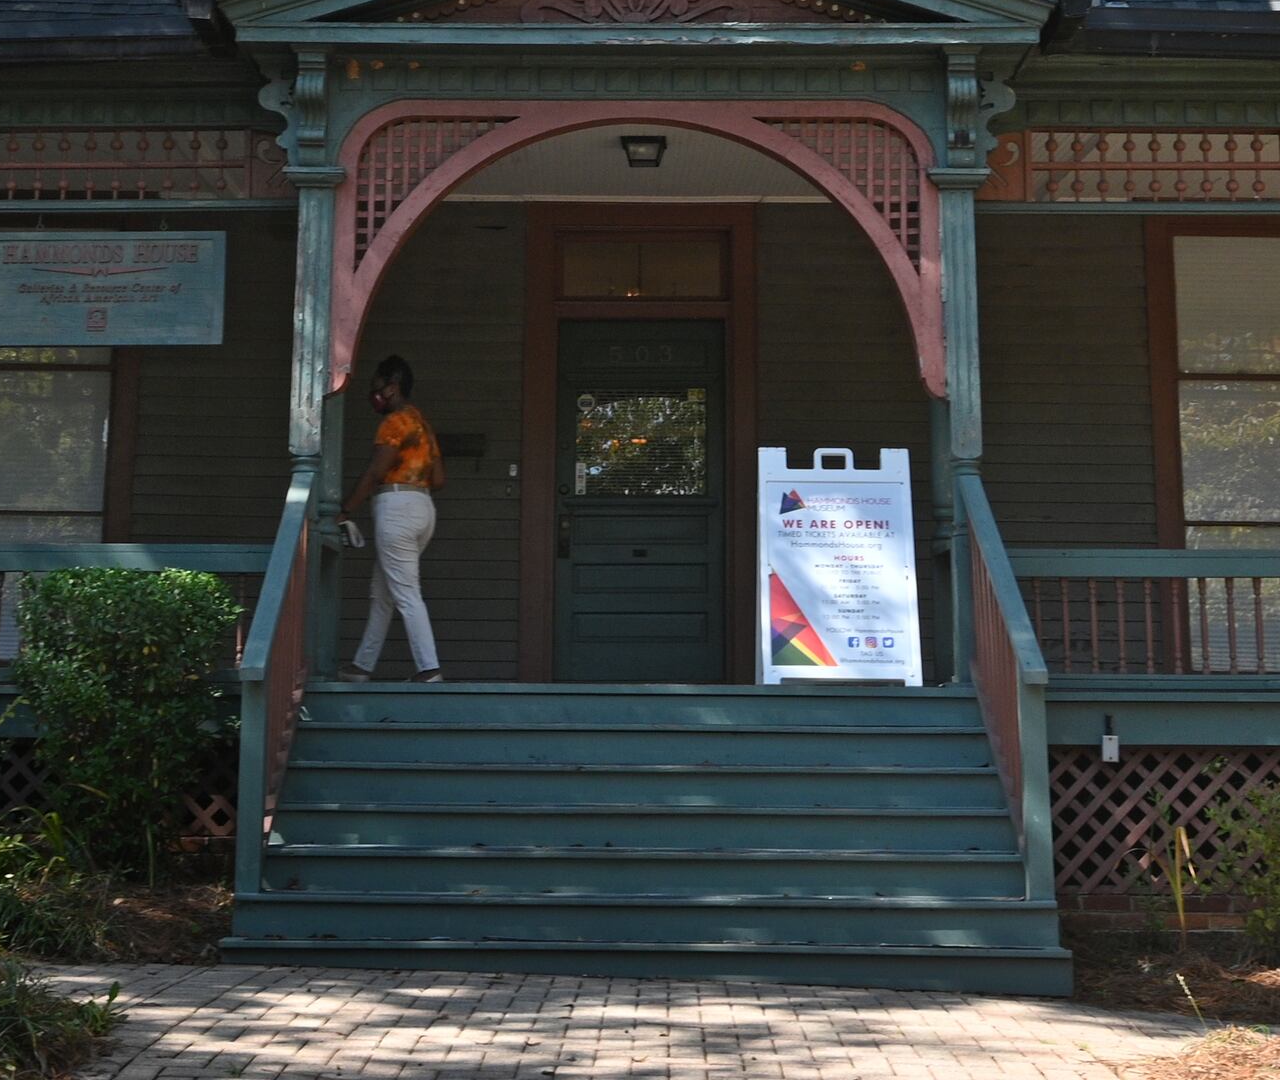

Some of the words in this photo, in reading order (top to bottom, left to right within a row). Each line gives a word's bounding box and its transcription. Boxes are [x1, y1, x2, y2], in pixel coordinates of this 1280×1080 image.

[3, 244, 123, 264] HAMMONDS
[133, 244, 198, 264] HOUSE
[610, 345, 672, 363] 503
[807, 504, 846, 512] MUSEUM
[782, 519, 803, 529] WE
[810, 519, 836, 529] ARE
[843, 520, 890, 530] OPEN!
